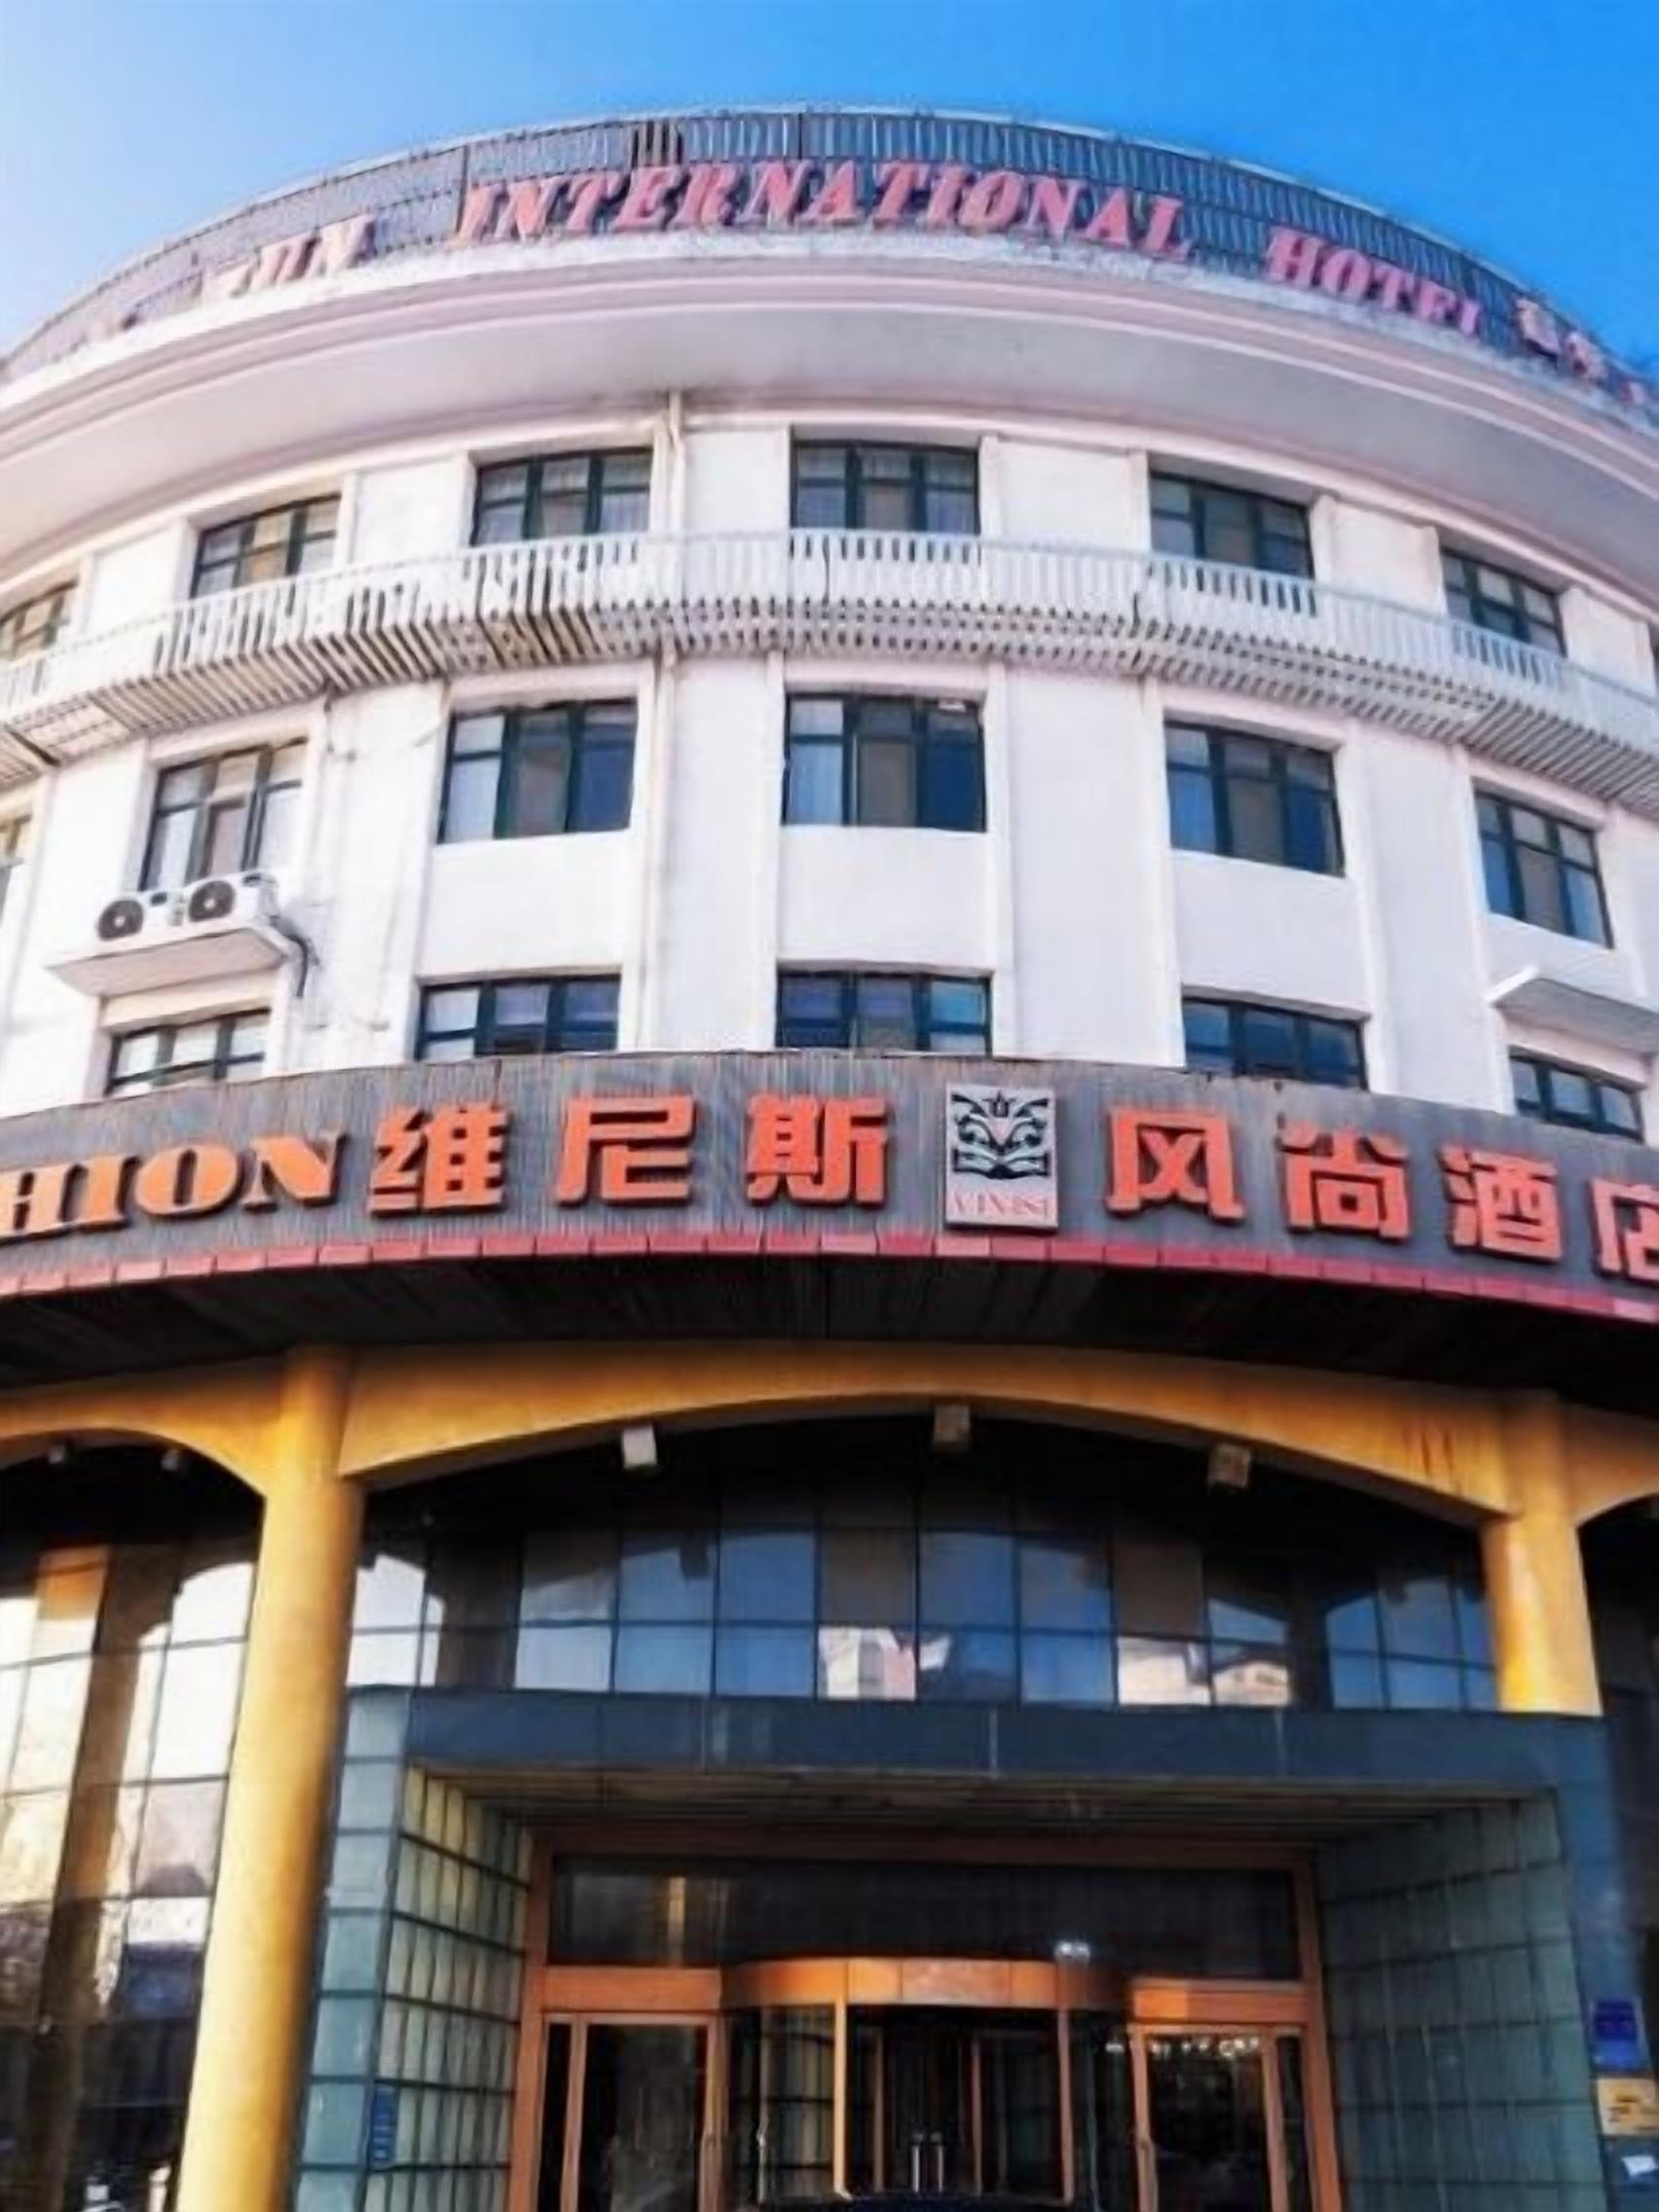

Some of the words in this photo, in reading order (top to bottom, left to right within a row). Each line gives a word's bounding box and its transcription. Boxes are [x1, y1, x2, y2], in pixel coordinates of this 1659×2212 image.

[456, 160, 1187, 259] INTERNATIONAL
[370, 1094, 890, 1213] 维尼斯
[1105, 1108, 1659, 1281] 风尚酒店
